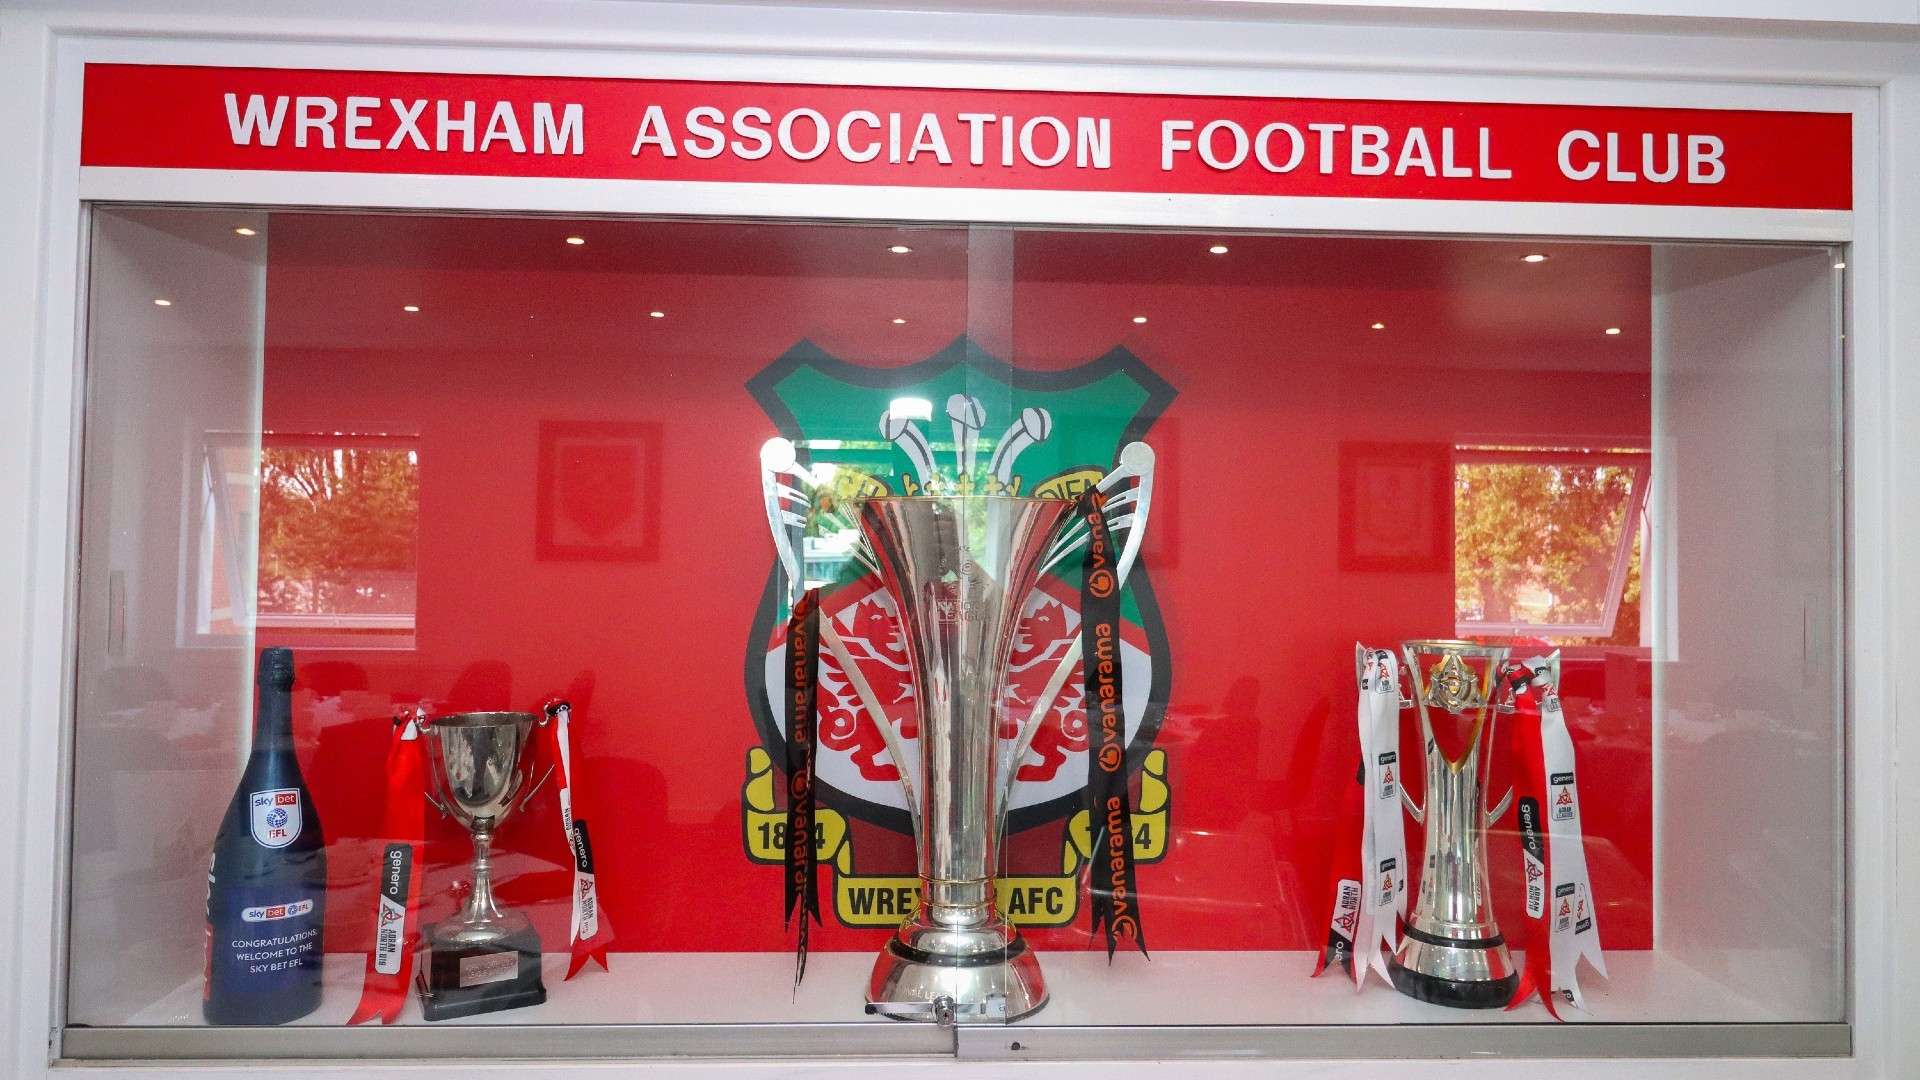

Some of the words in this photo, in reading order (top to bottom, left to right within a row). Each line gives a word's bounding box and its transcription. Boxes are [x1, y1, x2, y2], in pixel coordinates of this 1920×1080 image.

[225, 94, 584, 155] WREXHAM
[631, 105, 1111, 169] ASSOCIATION
[1161, 119, 1512, 179] FOOTBALL
[1557, 129, 1726, 184] CLUB
[794, 623, 807, 744] vanarama
[1095, 623, 1117, 743] vanarama
[254, 797, 273, 807] sky
[276, 794, 296, 805] bet
[758, 822, 826, 849] 184
[1521, 804, 1536, 850] genero
[574, 828, 589, 868] genero
[1107, 796, 1127, 915] vanarama
[389, 850, 402, 895] genero
[1008, 887, 1063, 915] AFC
[1341, 885, 1351, 910] ADRAN
[249, 910, 265, 918] sky
[266, 907, 285, 918] bet
[236, 949, 284, 961] WELCOME
[285, 947, 298, 956] TO
[299, 942, 313, 953] THE
[379, 928, 388, 952] NORTH
[388, 929, 397, 953] ADRAN
[250, 964, 269, 974] SKY
[270, 961, 288, 971] BET
[289, 958, 303, 968] EFL
